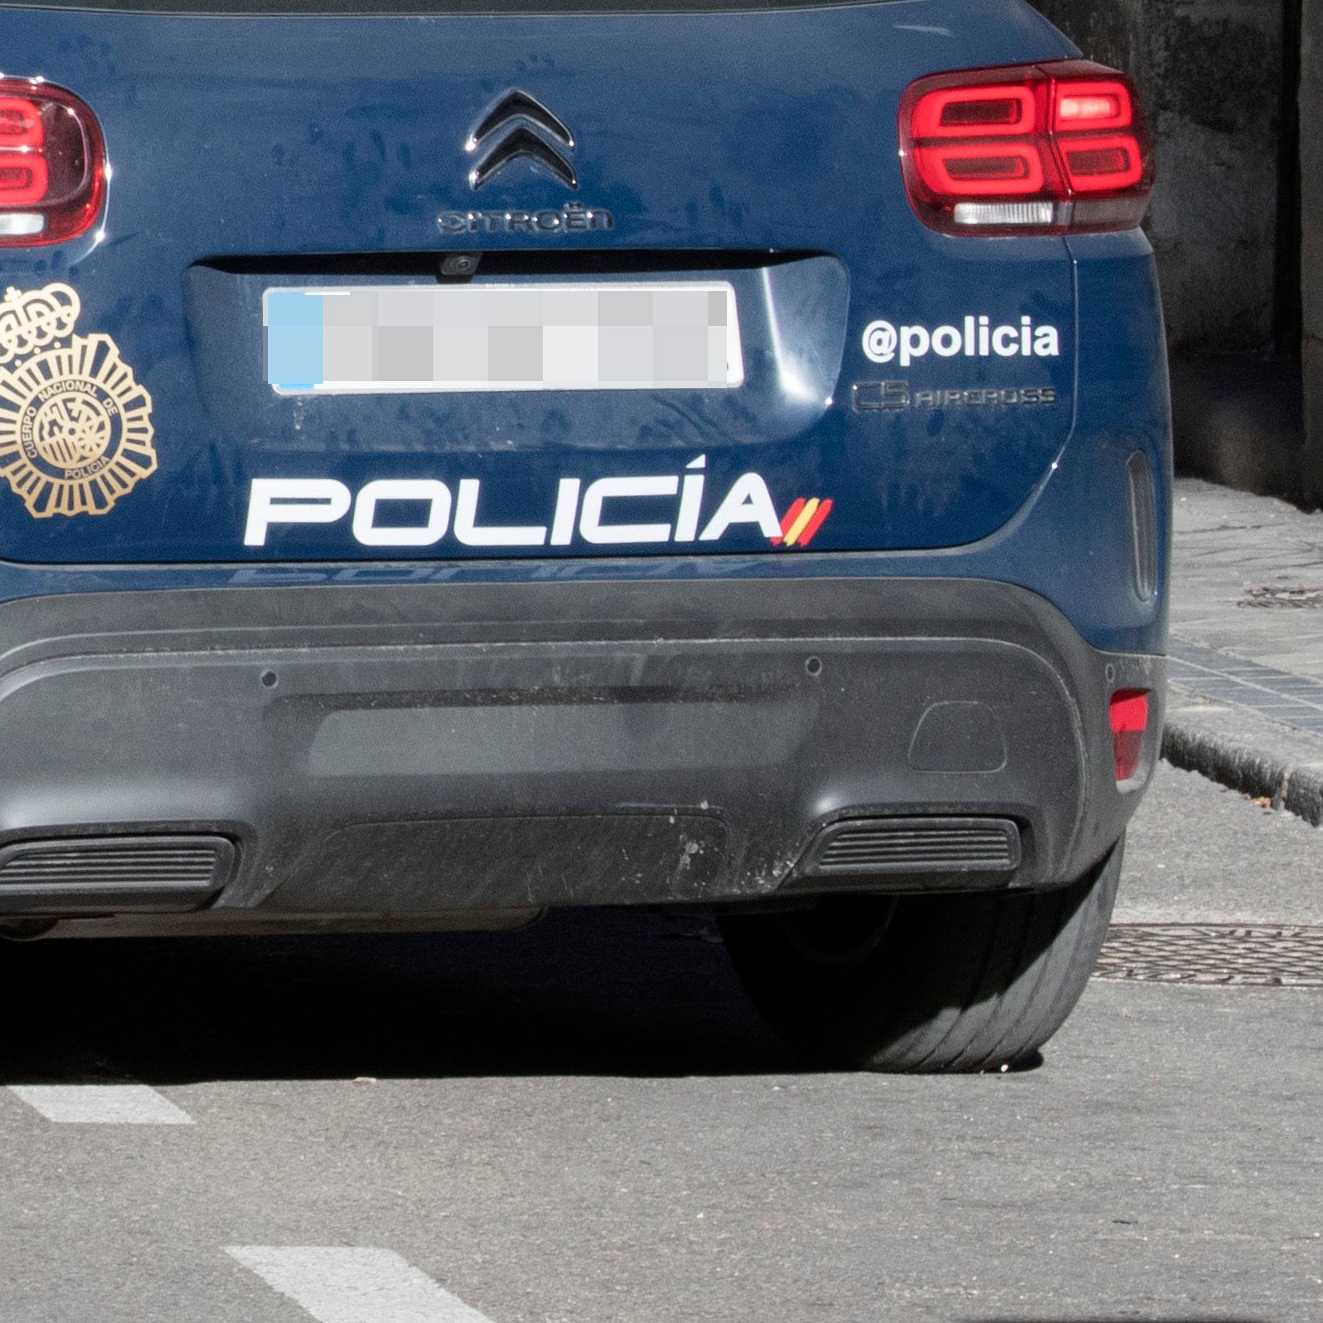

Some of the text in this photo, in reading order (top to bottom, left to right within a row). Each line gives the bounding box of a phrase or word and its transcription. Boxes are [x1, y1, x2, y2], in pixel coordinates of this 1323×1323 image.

[437, 201, 615, 234] CITROËN
[861, 315, 1060, 366] @policia
[852, 380, 1056, 412] C5 AIRCROSS
[22, 380, 118, 479] CUERPO NACIONAL DE POLICIA
[243, 454, 783, 546] POLICÍA
